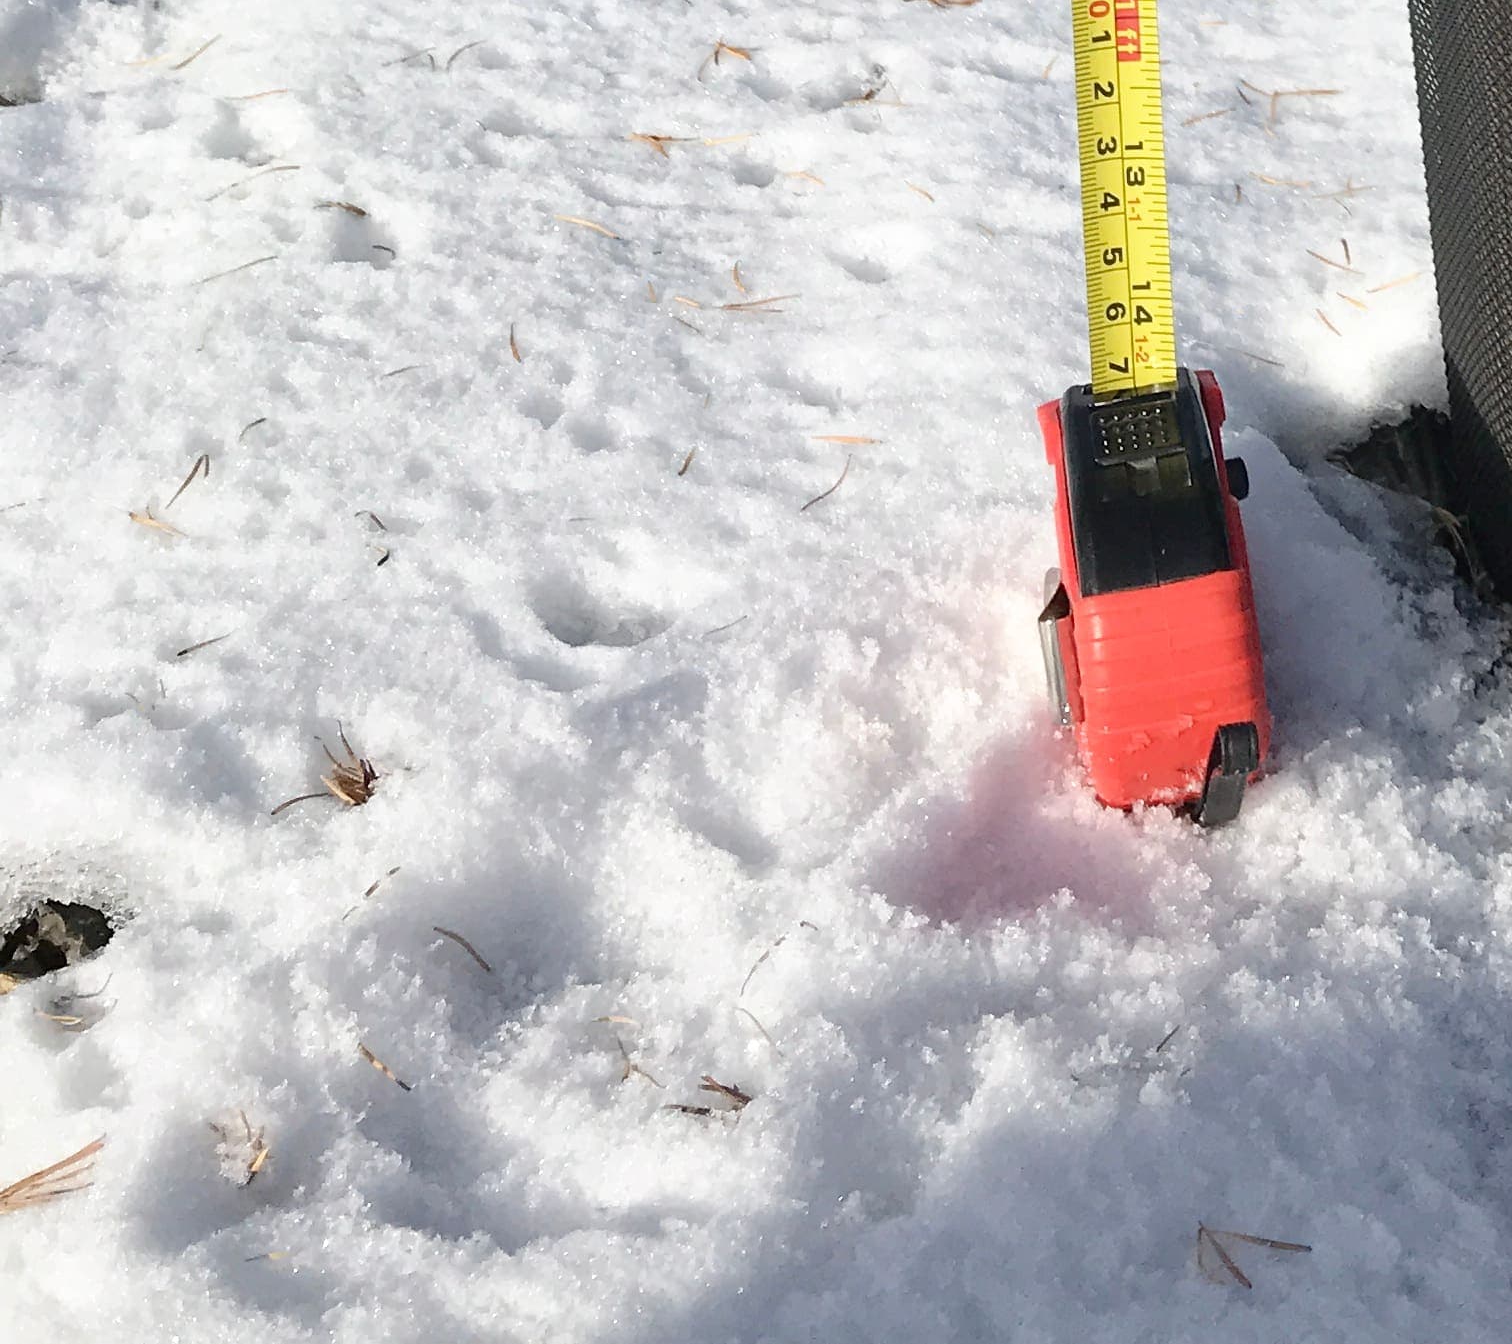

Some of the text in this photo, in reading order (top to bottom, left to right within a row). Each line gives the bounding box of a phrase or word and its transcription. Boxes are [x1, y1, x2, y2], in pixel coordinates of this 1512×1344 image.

[1091, 30, 1112, 44] 1
[1093, 80, 1115, 101] 2
[1096, 136, 1118, 156] 3
[1099, 191, 1121, 212] 4
[1102, 246, 1123, 266] 5
[1105, 302, 1126, 322] 6
[1108, 356, 1129, 375] 7
